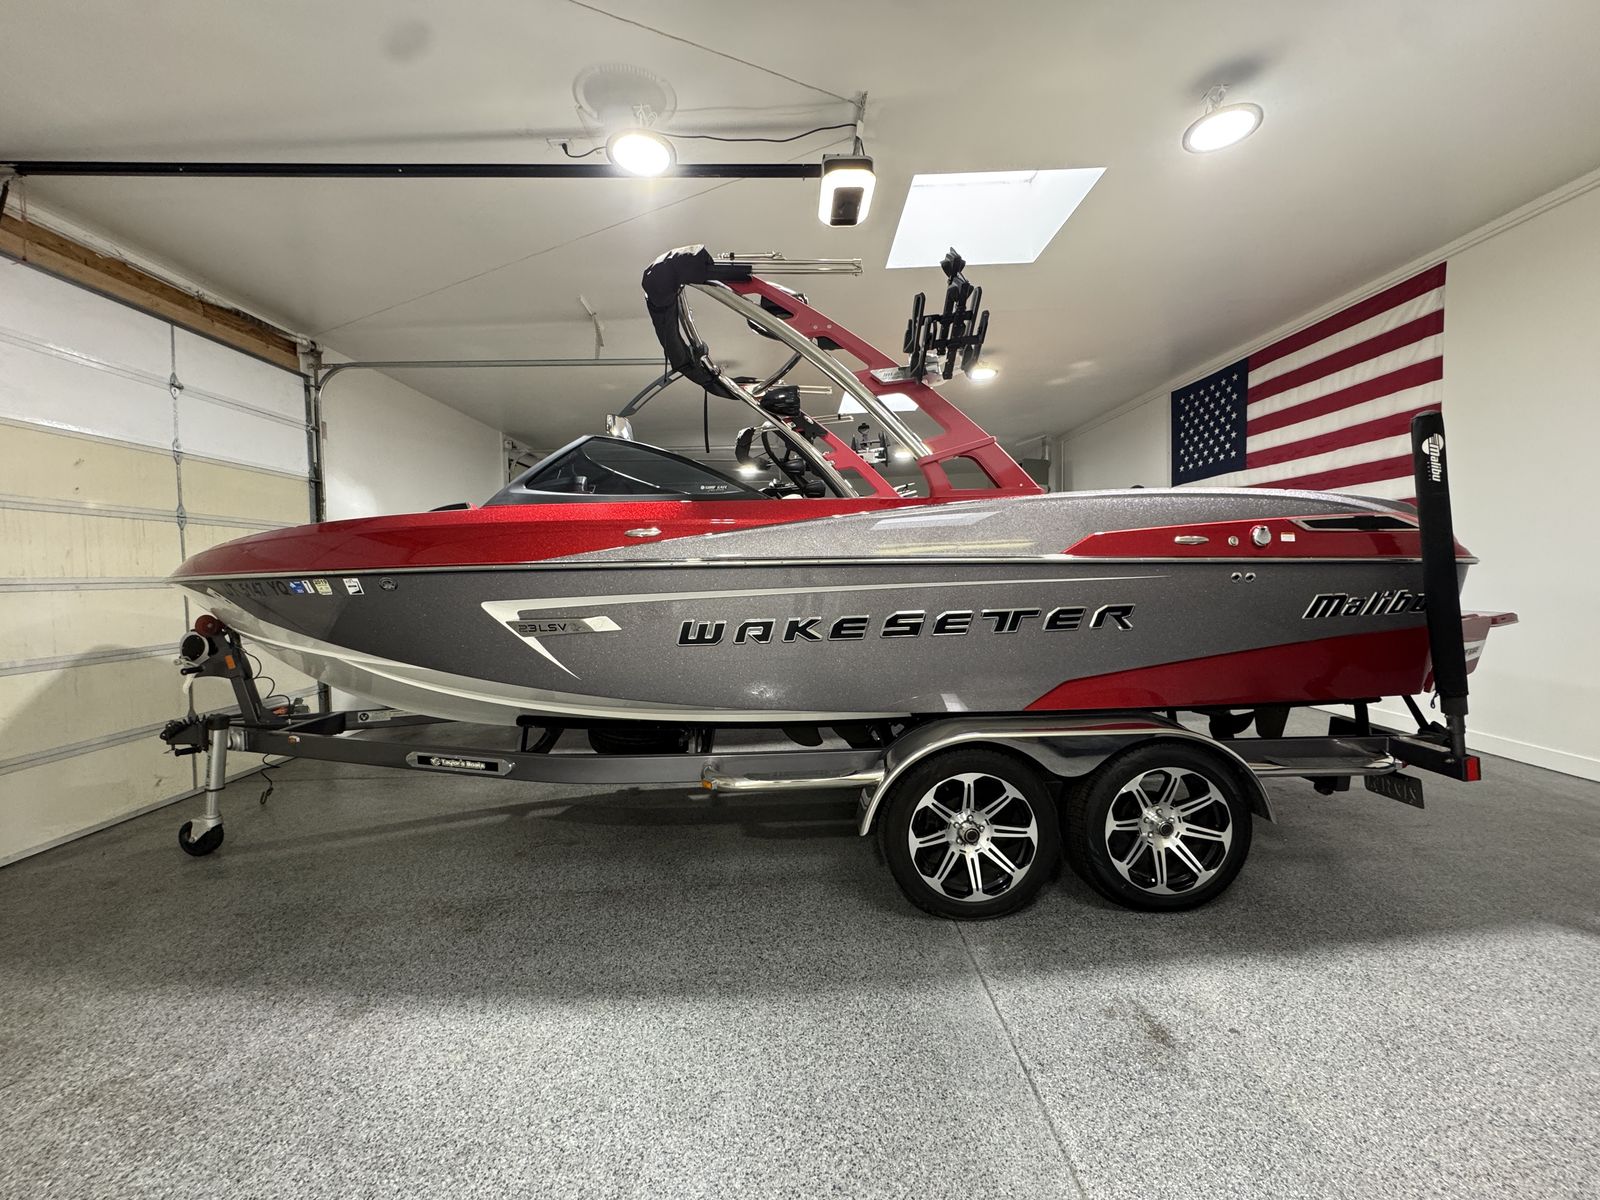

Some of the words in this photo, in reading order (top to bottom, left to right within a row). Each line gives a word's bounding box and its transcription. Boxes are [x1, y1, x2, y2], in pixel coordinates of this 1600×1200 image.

[1429, 443, 1442, 482] Malibu
[266, 580, 292, 596] YQ
[518, 623, 567, 633] 23LSV
[676, 603, 1137, 647] WAKESETTER
